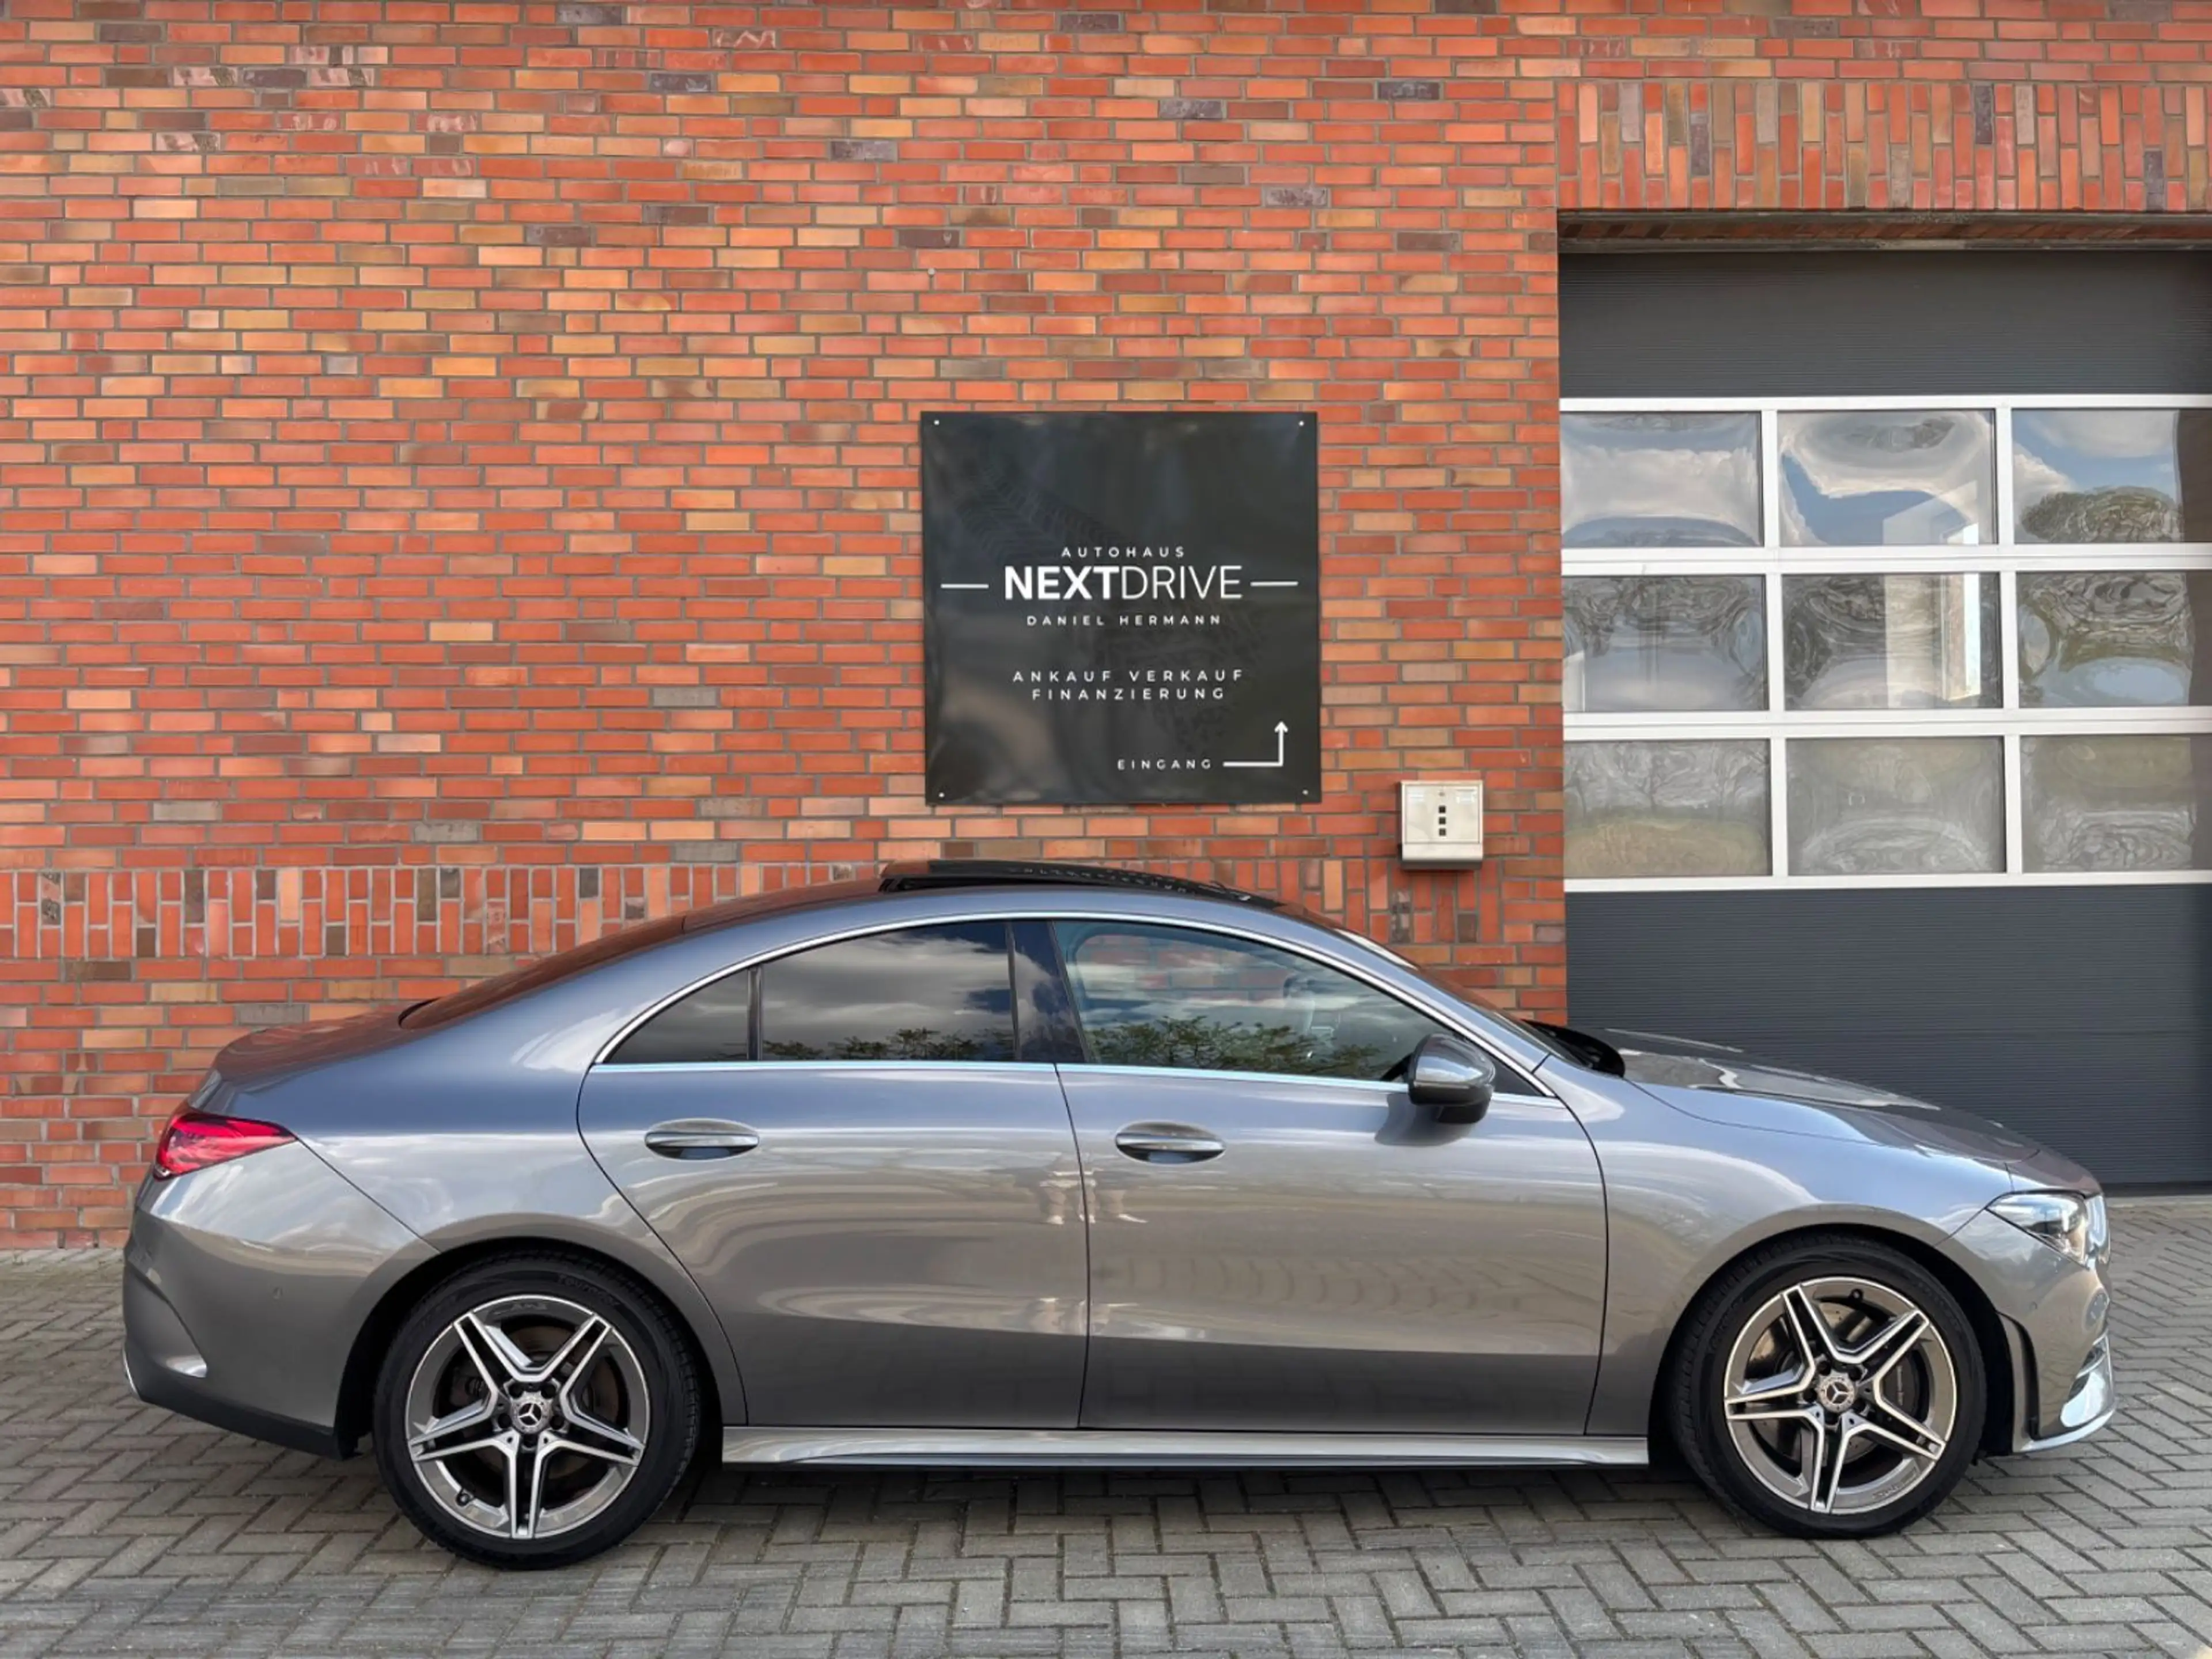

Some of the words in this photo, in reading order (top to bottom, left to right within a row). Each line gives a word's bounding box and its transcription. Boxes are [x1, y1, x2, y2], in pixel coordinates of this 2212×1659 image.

[1061, 546, 1184, 558] AUTOHAUS
[1005, 565, 1243, 600] NEXTDRIVE
[1027, 615, 1105, 626] DANIEL
[1119, 615, 1221, 626] HERMANN
[1013, 670, 1112, 683] ANKAUF
[1129, 669, 1243, 683] VERKAUF
[1032, 687, 1224, 700] FINANZIERUNG
[1118, 759, 1211, 770] EINGANG
